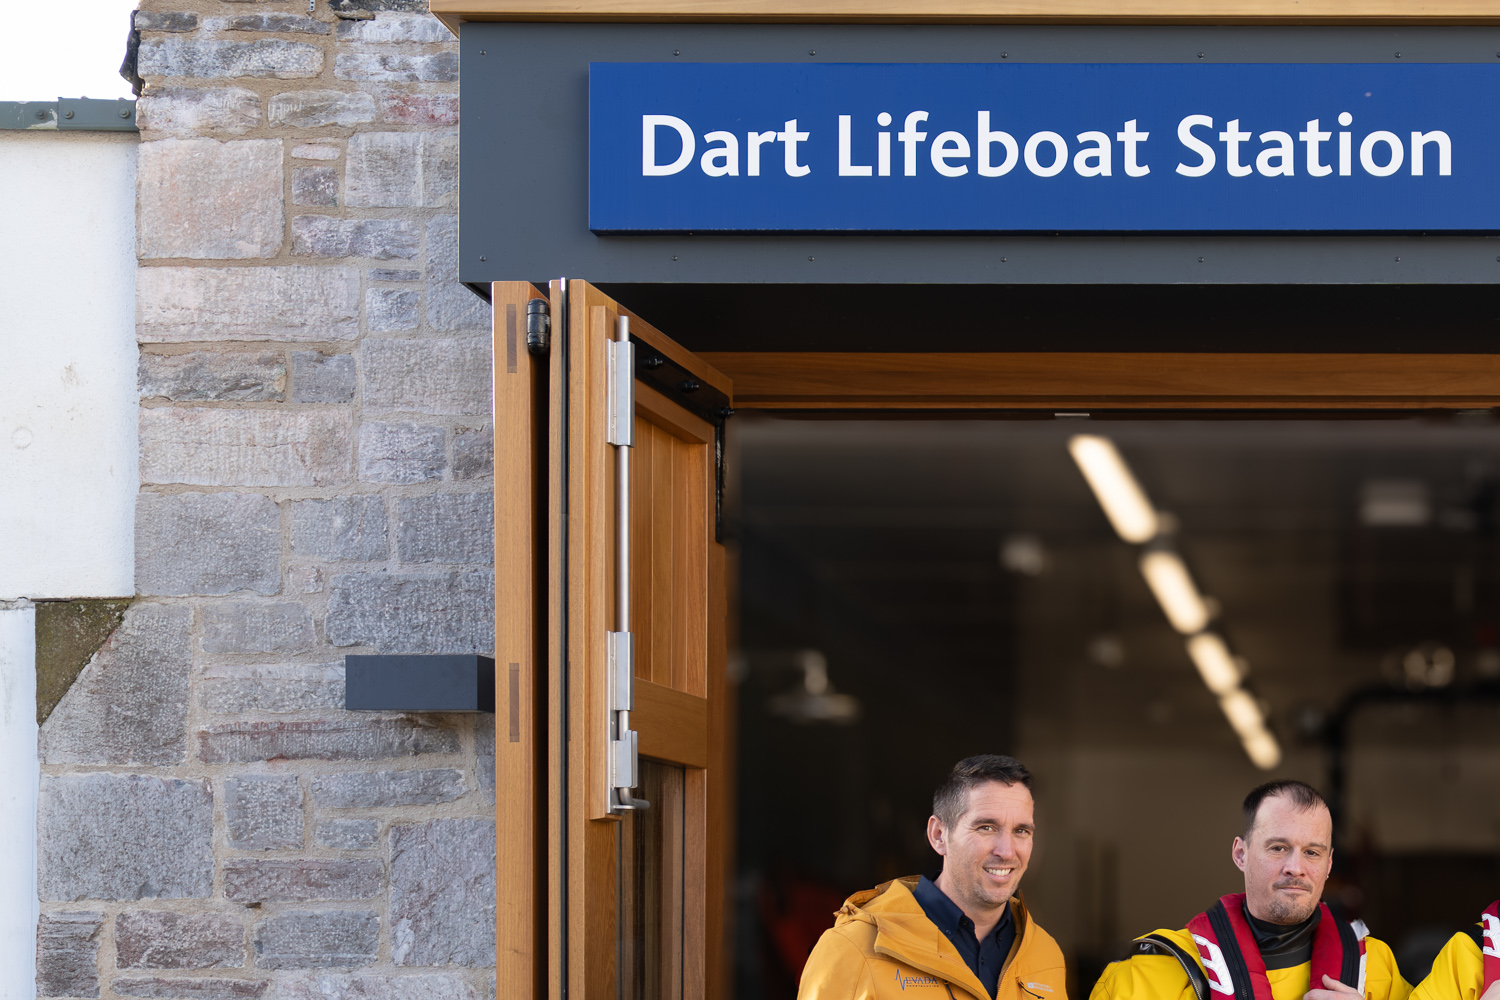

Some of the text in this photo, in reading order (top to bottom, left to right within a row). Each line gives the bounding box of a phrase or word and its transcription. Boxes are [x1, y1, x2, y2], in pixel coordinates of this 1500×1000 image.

[643, 110, 1452, 178] Dart Lifeboat Station
